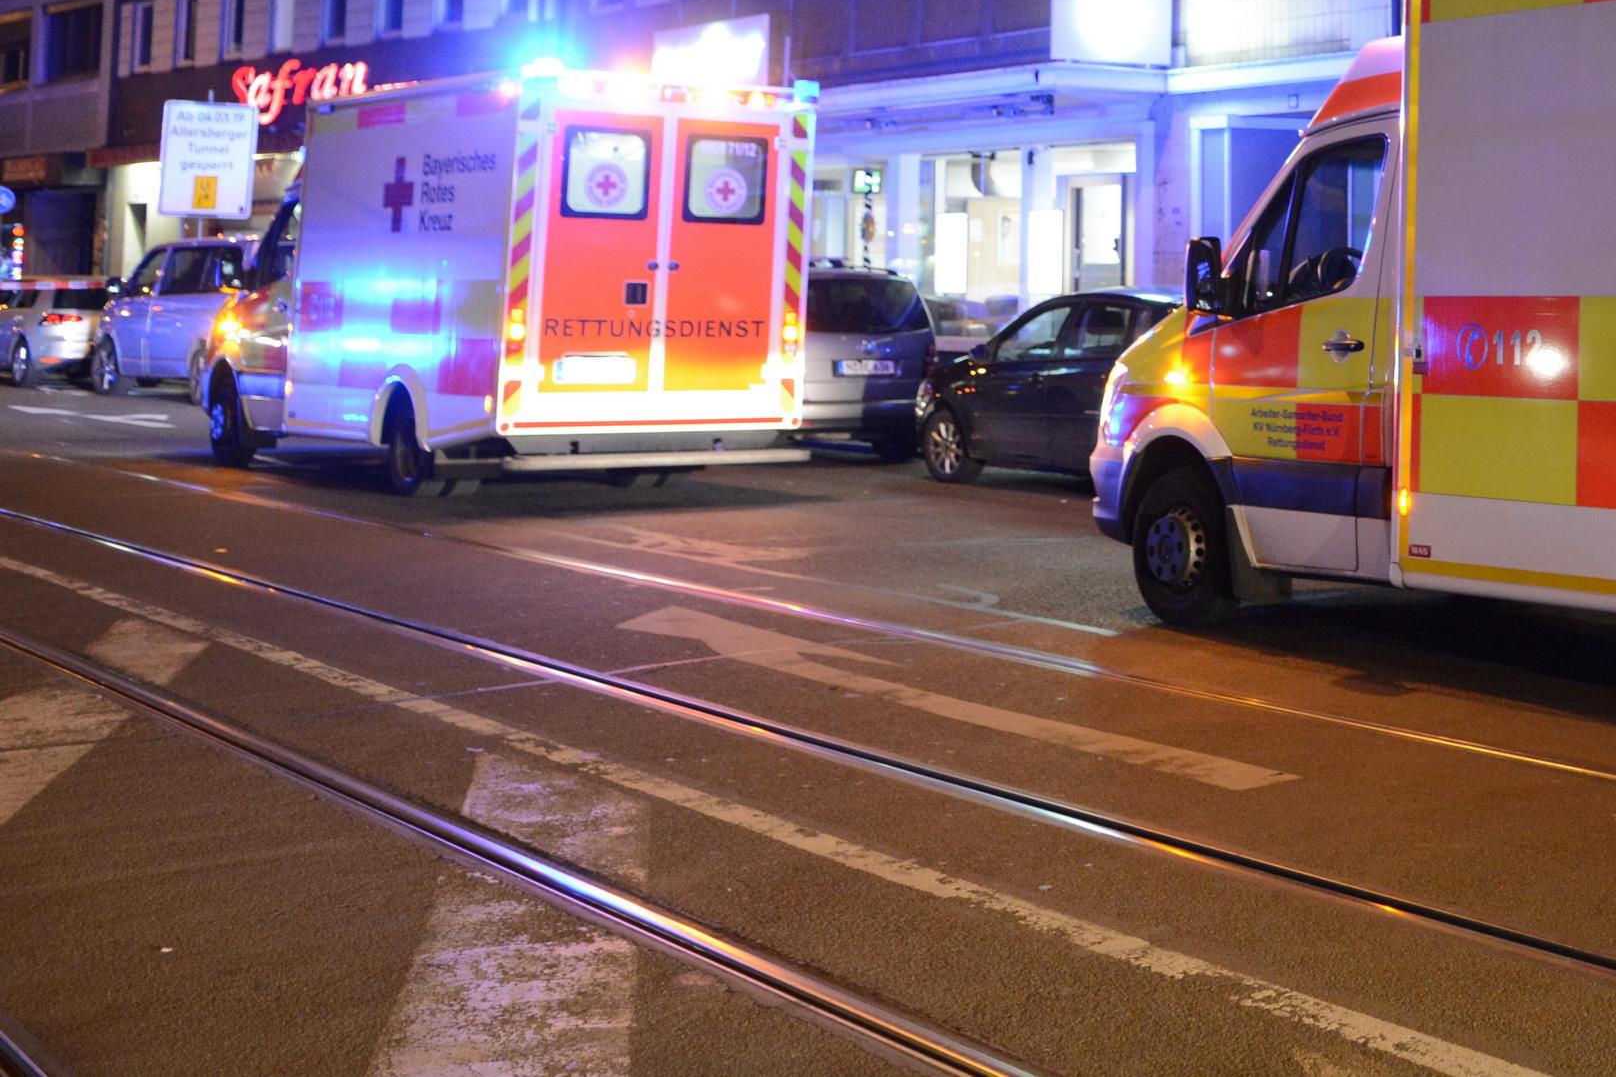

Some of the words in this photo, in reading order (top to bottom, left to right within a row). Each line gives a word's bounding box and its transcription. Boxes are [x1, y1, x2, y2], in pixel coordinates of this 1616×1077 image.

[231, 58, 369, 126] Safran
[170, 126, 248, 141] Allersberger
[187, 141, 230, 155] Tunnel
[179, 161, 235, 173] gesperrt
[422, 150, 497, 179] Bayerisches
[421, 181, 455, 203] Rotes
[419, 210, 453, 232] Kreuz
[544, 318, 765, 339] RETTUNGSDIENST
[1252, 422, 1264, 432] KV
[1267, 436, 1327, 451] Rettungsdienst
